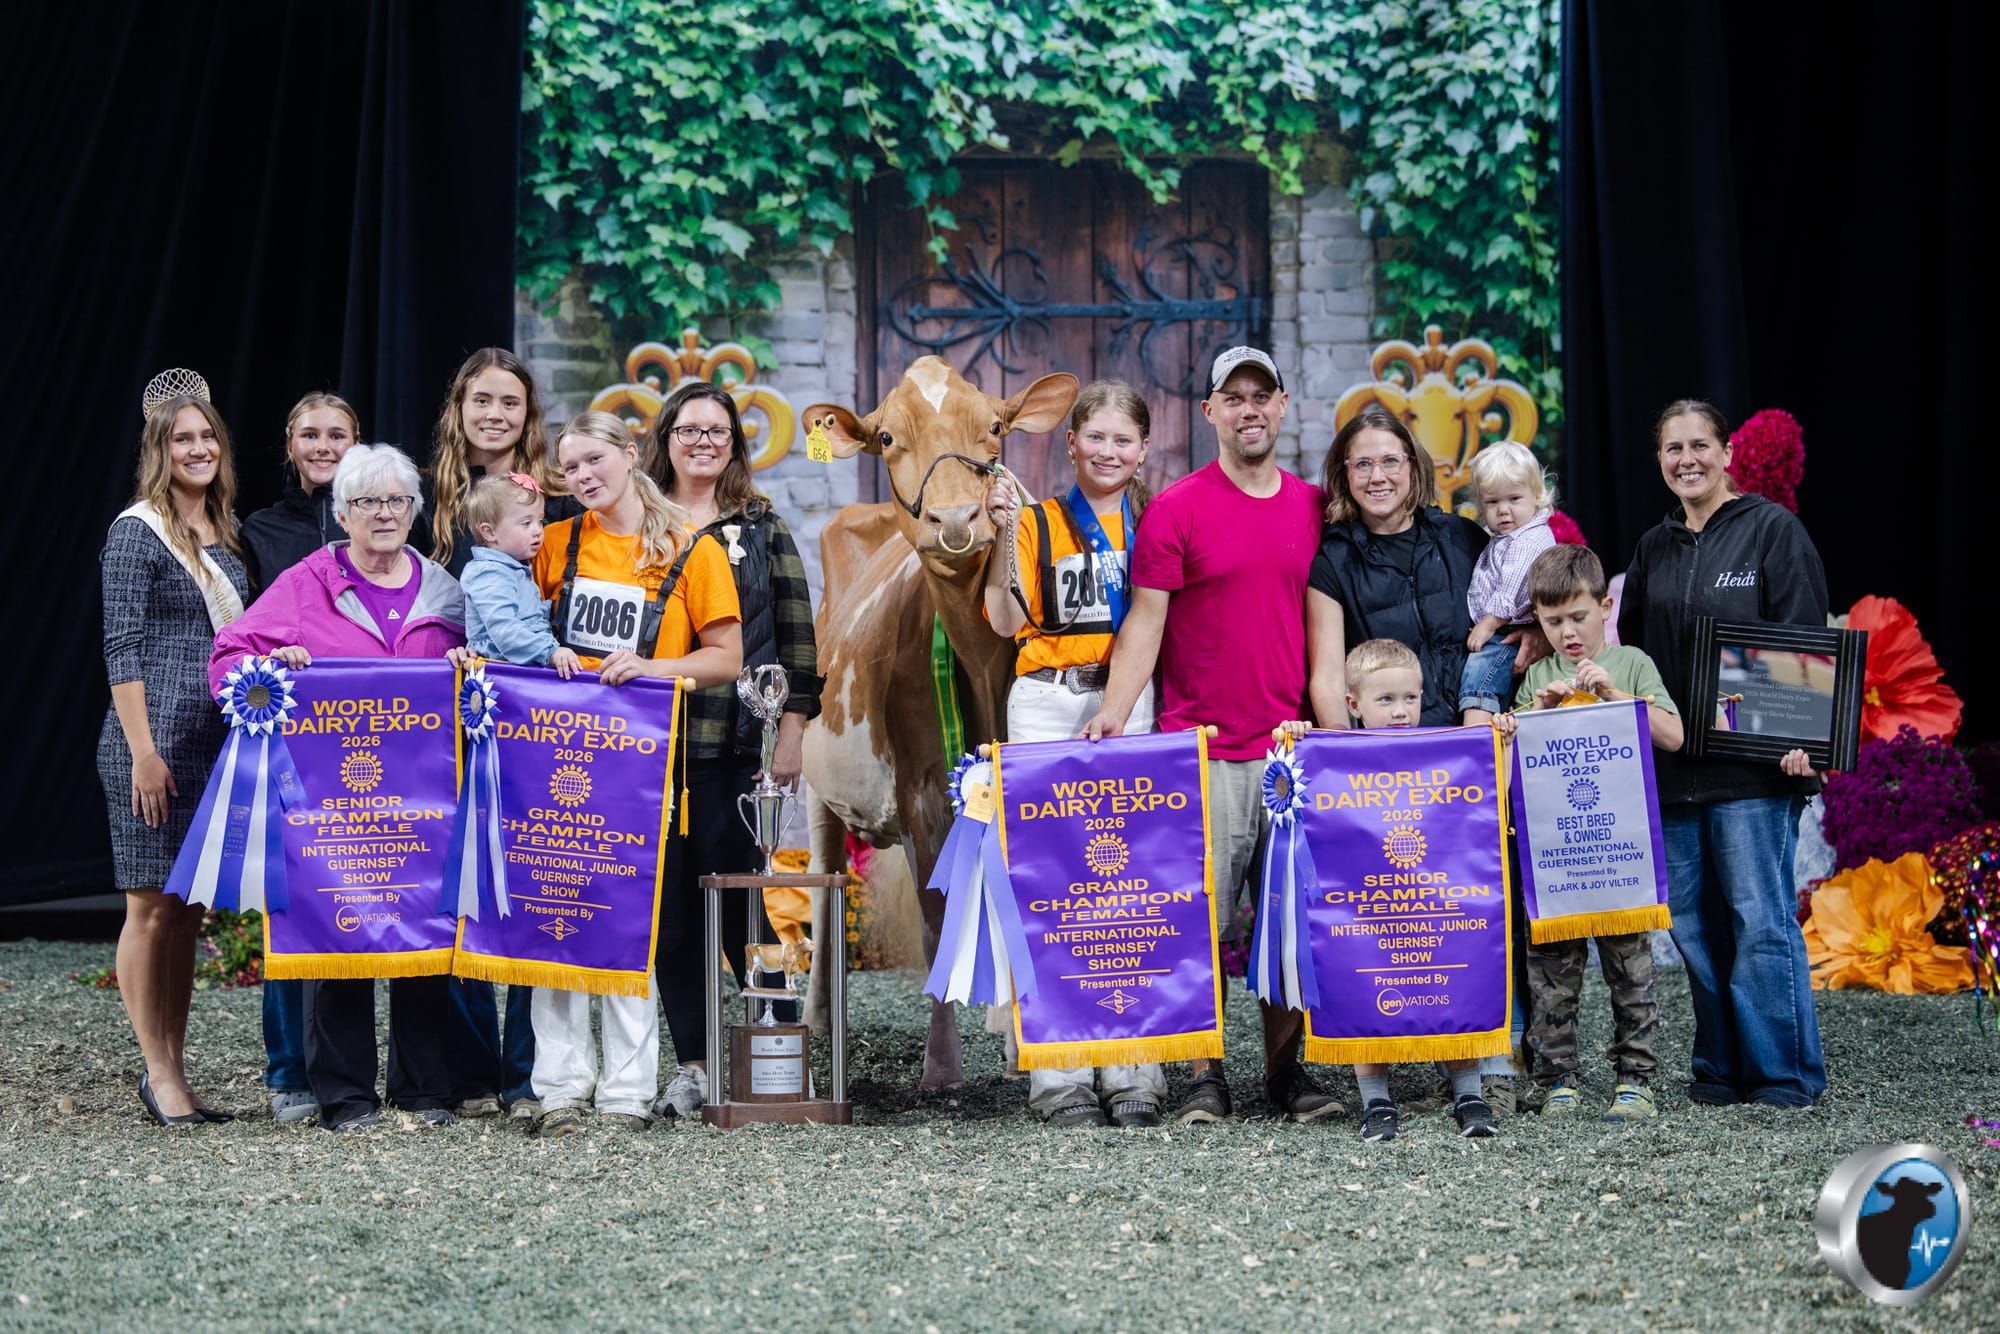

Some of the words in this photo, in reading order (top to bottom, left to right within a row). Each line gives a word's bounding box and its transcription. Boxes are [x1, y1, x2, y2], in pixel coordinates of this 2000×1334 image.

[1714, 570, 1756, 588] Heidi
[1062, 568, 1126, 608] 208
[572, 593, 637, 640] 2086
[312, 698, 409, 717] WORLD
[282, 716, 361, 735] DAIRY
[369, 713, 441, 732] EXPO
[530, 708, 627, 733] WORLD
[341, 736, 380, 748] 2026
[496, 722, 576, 745] DAIRY
[583, 731, 657, 755] EXPO
[1545, 735, 1611, 753] WORLD
[553, 748, 594, 762] 2026
[1525, 751, 1579, 769] DAIRY
[1584, 746, 1634, 763] EXPO
[1348, 769, 1450, 790] WORLD
[1561, 765, 1601, 777] 2026
[1052, 777, 1153, 799] WORLD
[322, 796, 402, 810] SENIOR
[1019, 798, 1103, 820] DAIRY
[1112, 792, 1187, 814] EXPO
[1315, 791, 1400, 810] DAIRY
[1409, 785, 1484, 805] EXPO
[288, 809, 443, 825] CHAMPION
[528, 807, 606, 826] GRAND
[1084, 817, 1125, 831] 2026
[1382, 809, 1423, 822] 2026
[1557, 815, 1584, 830] BEST
[1587, 812, 1616, 827] BRED
[317, 823, 413, 835] FEMALE
[1563, 831, 1572, 844] &
[1573, 828, 1612, 843] OWNED
[302, 842, 430, 857] INTERNATIONAL
[517, 834, 613, 853] FEMALE
[1541, 841, 1638, 858] INTERNATIONAL
[328, 856, 407, 871] GUERNSEY
[505, 852, 587, 872] TERNATIONAL
[589, 861, 637, 877] JUNIOR
[1538, 856, 1604, 870] GUERNSEY
[1607, 851, 1644, 863] SHOW
[343, 872, 391, 884] SHOW
[531, 869, 593, 886] GUERNSEY
[1363, 872, 1448, 887] SENIOR
[1567, 868, 1606, 878] Presented
[1607, 867, 1618, 876] By
[541, 885, 580, 899] SHOW
[1068, 879, 1149, 894] GRAND
[1548, 882, 1579, 894] CLARK
[1580, 881, 1587, 891] &
[1589, 879, 1606, 890] JOY
[1608, 876, 1639, 888] VILTER
[334, 893, 384, 903] Presented
[386, 893, 400, 904] By
[1029, 890, 1193, 912] CHAMPION
[1325, 885, 1490, 903] CHAMPION
[524, 903, 578, 917] Presented
[580, 908, 594, 920] By
[1061, 907, 1162, 922] FEMALE
[1357, 900, 1460, 914] FEMALE
[1044, 925, 1181, 944] INTERNATIONAL
[1331, 921, 1436, 937] INTERNATIONAL
[1439, 919, 1487, 931] JUNIOR
[1071, 941, 1157, 957] GUERNSEY
[1378, 936, 1444, 949] GUERNSEY
[1088, 956, 1142, 971] SHOW
[1391, 952, 1432, 964] SHOW
[1080, 977, 1135, 989] Presented
[1138, 976, 1153, 987] By
[1375, 975, 1431, 986] Presented
[1434, 974, 1449, 986] By
